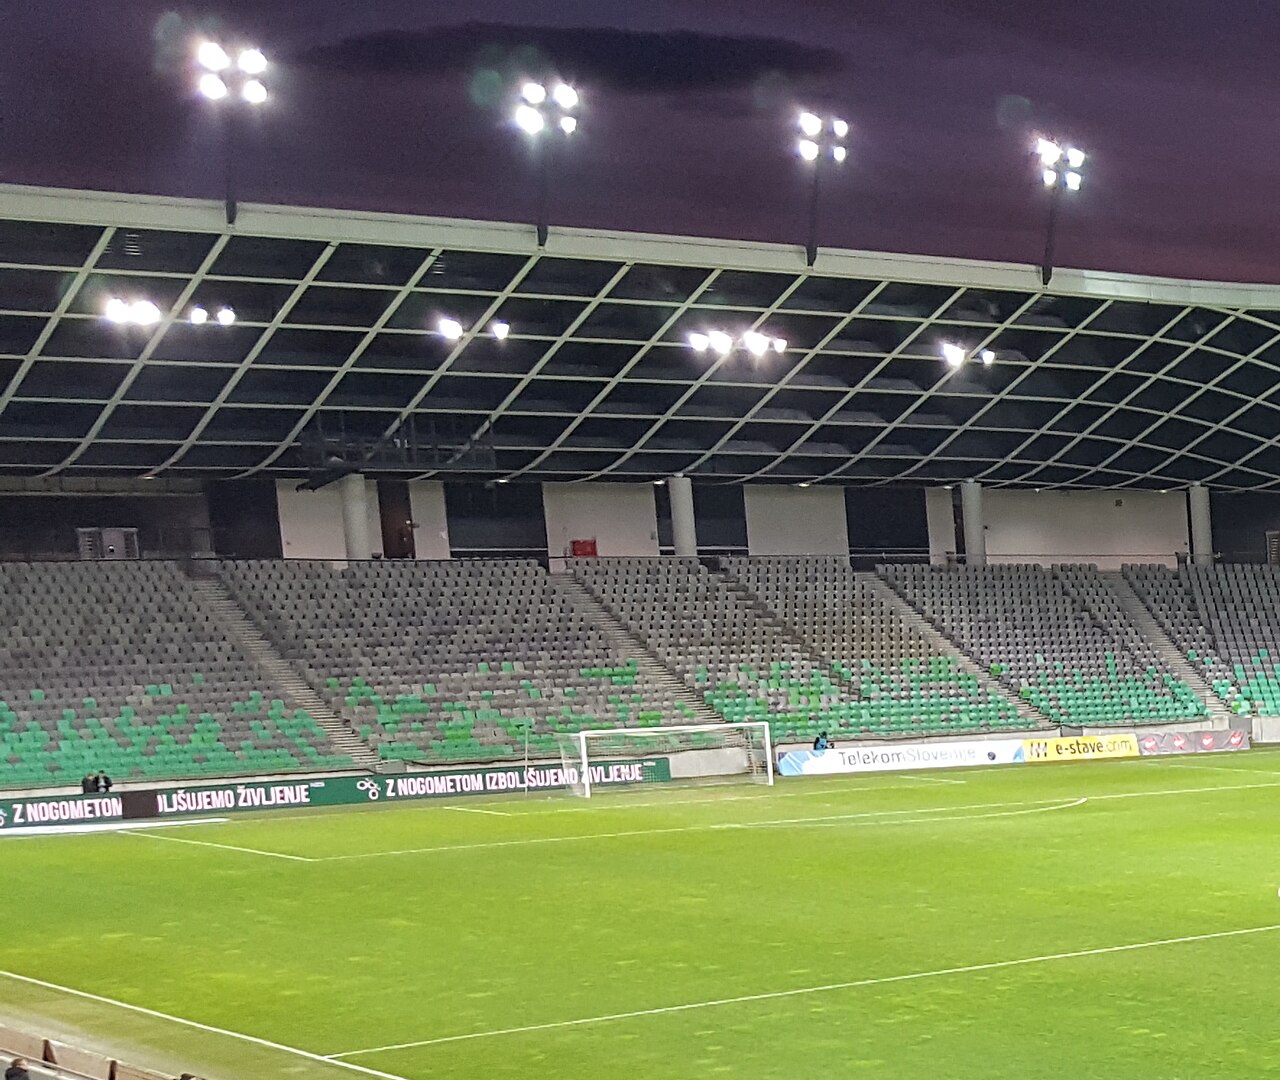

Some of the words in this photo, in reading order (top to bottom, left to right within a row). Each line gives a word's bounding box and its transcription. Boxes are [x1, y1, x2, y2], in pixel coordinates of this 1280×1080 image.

[386, 779, 396, 796] Z
[397, 773, 484, 796] NOGOMETOM
[486, 767, 578, 790] IZBOLJŠUJEMO
[236, 784, 311, 807] ŽIVLJENJE
[12, 804, 24, 823] Z
